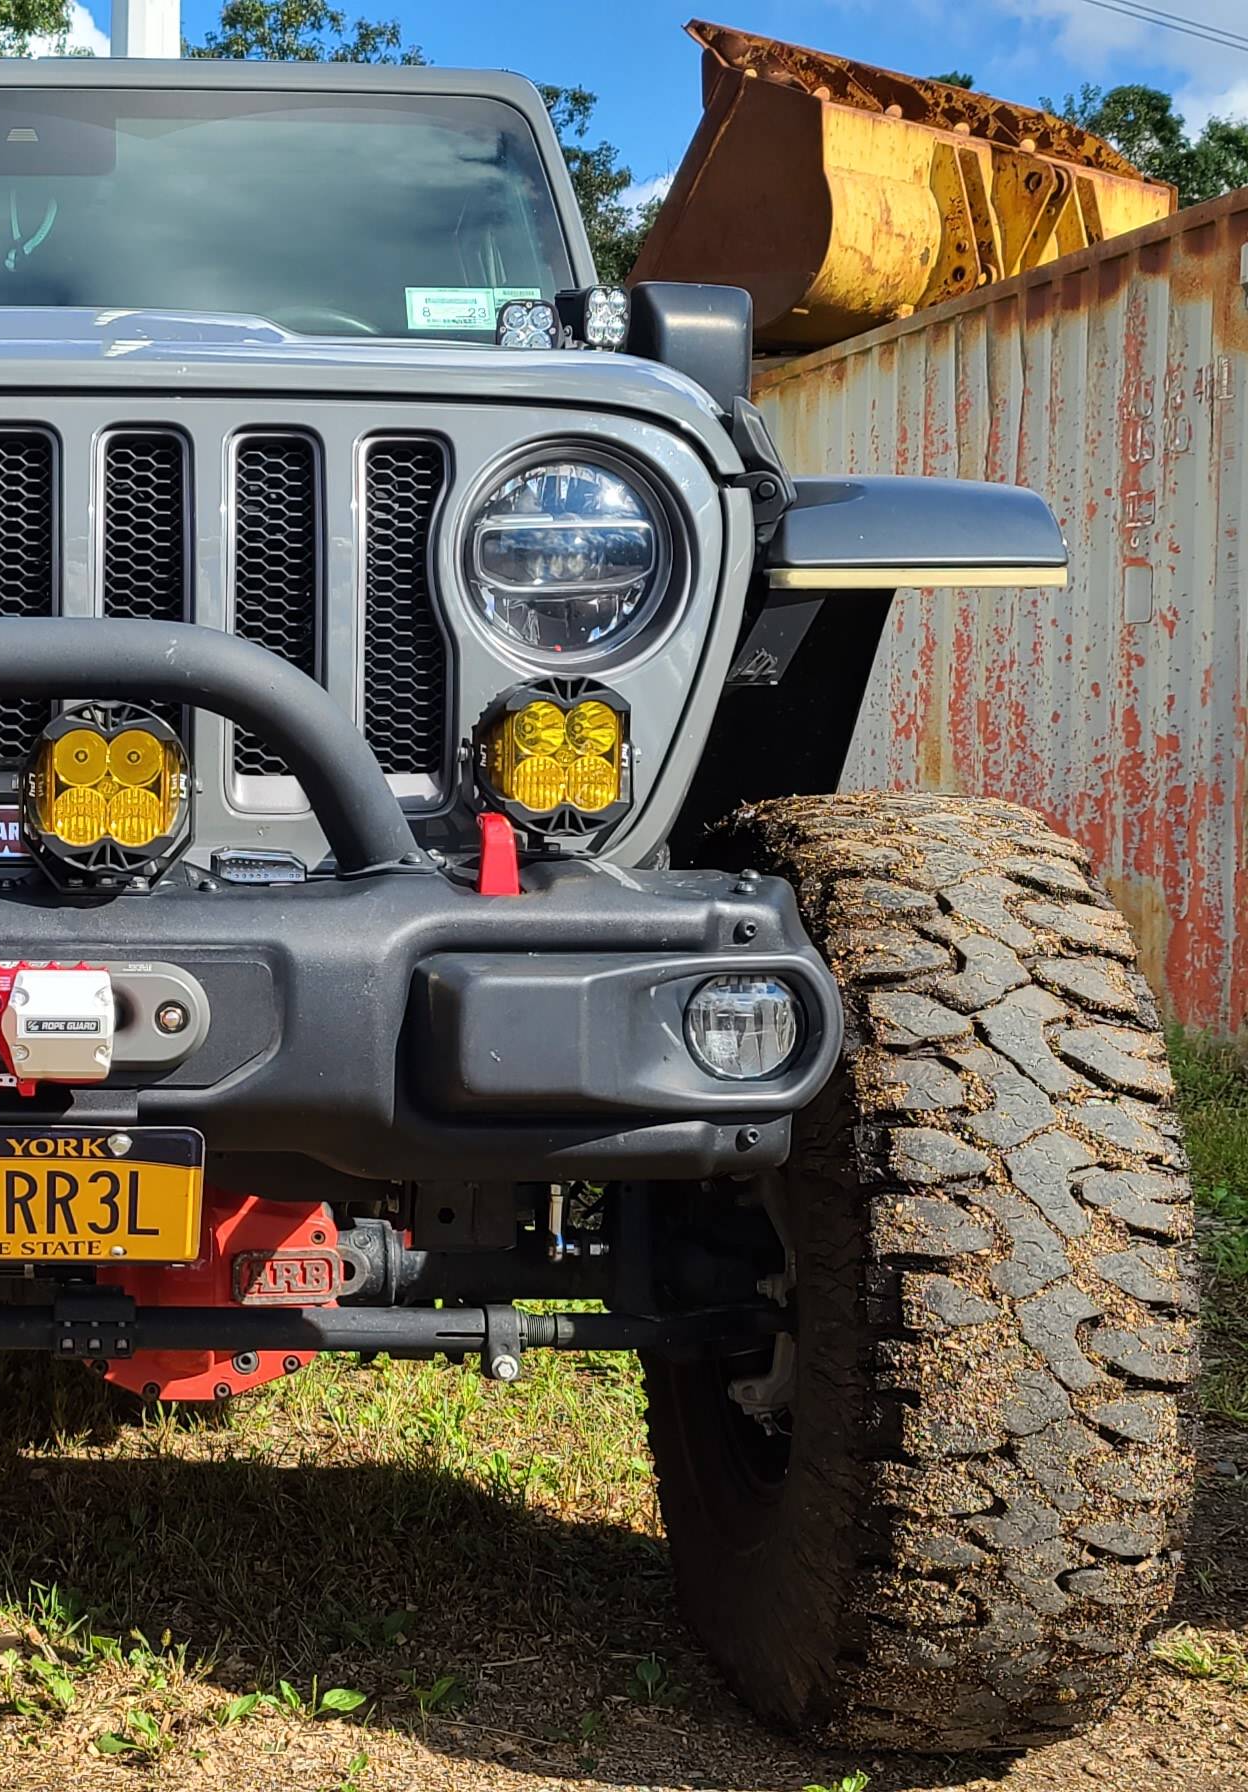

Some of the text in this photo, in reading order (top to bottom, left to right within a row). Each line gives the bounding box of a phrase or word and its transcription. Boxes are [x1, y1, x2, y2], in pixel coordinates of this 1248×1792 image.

[422, 306, 487, 318] 8 23
[41, 1021, 97, 1030] ROPE GUARD
[6, 1137, 107, 1157] YORK
[21, 1240, 102, 1256] STATE
[247, 1261, 328, 1292] ARB
